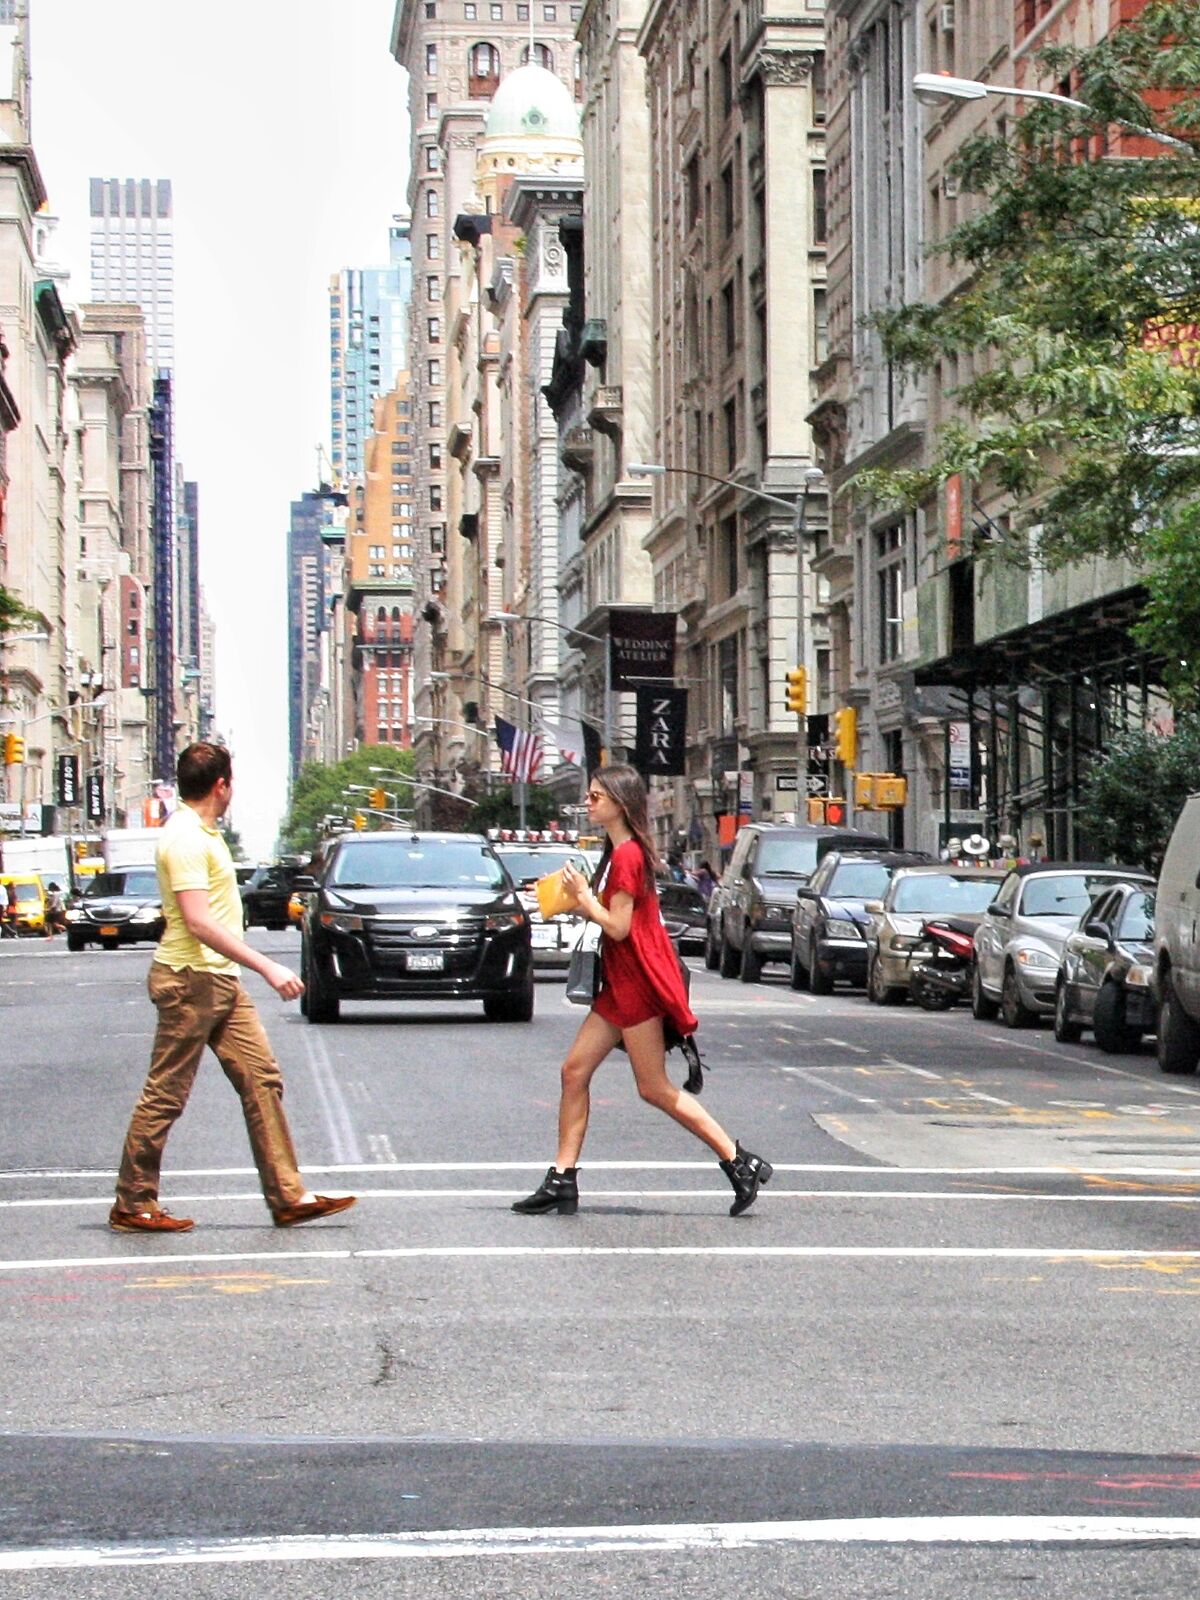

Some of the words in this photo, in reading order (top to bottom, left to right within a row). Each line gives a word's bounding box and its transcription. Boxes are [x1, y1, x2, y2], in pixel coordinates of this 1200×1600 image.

[613, 637, 672, 649] WEDDING
[618, 650, 668, 661] ATELIER
[651, 699, 672, 765] ZARA
